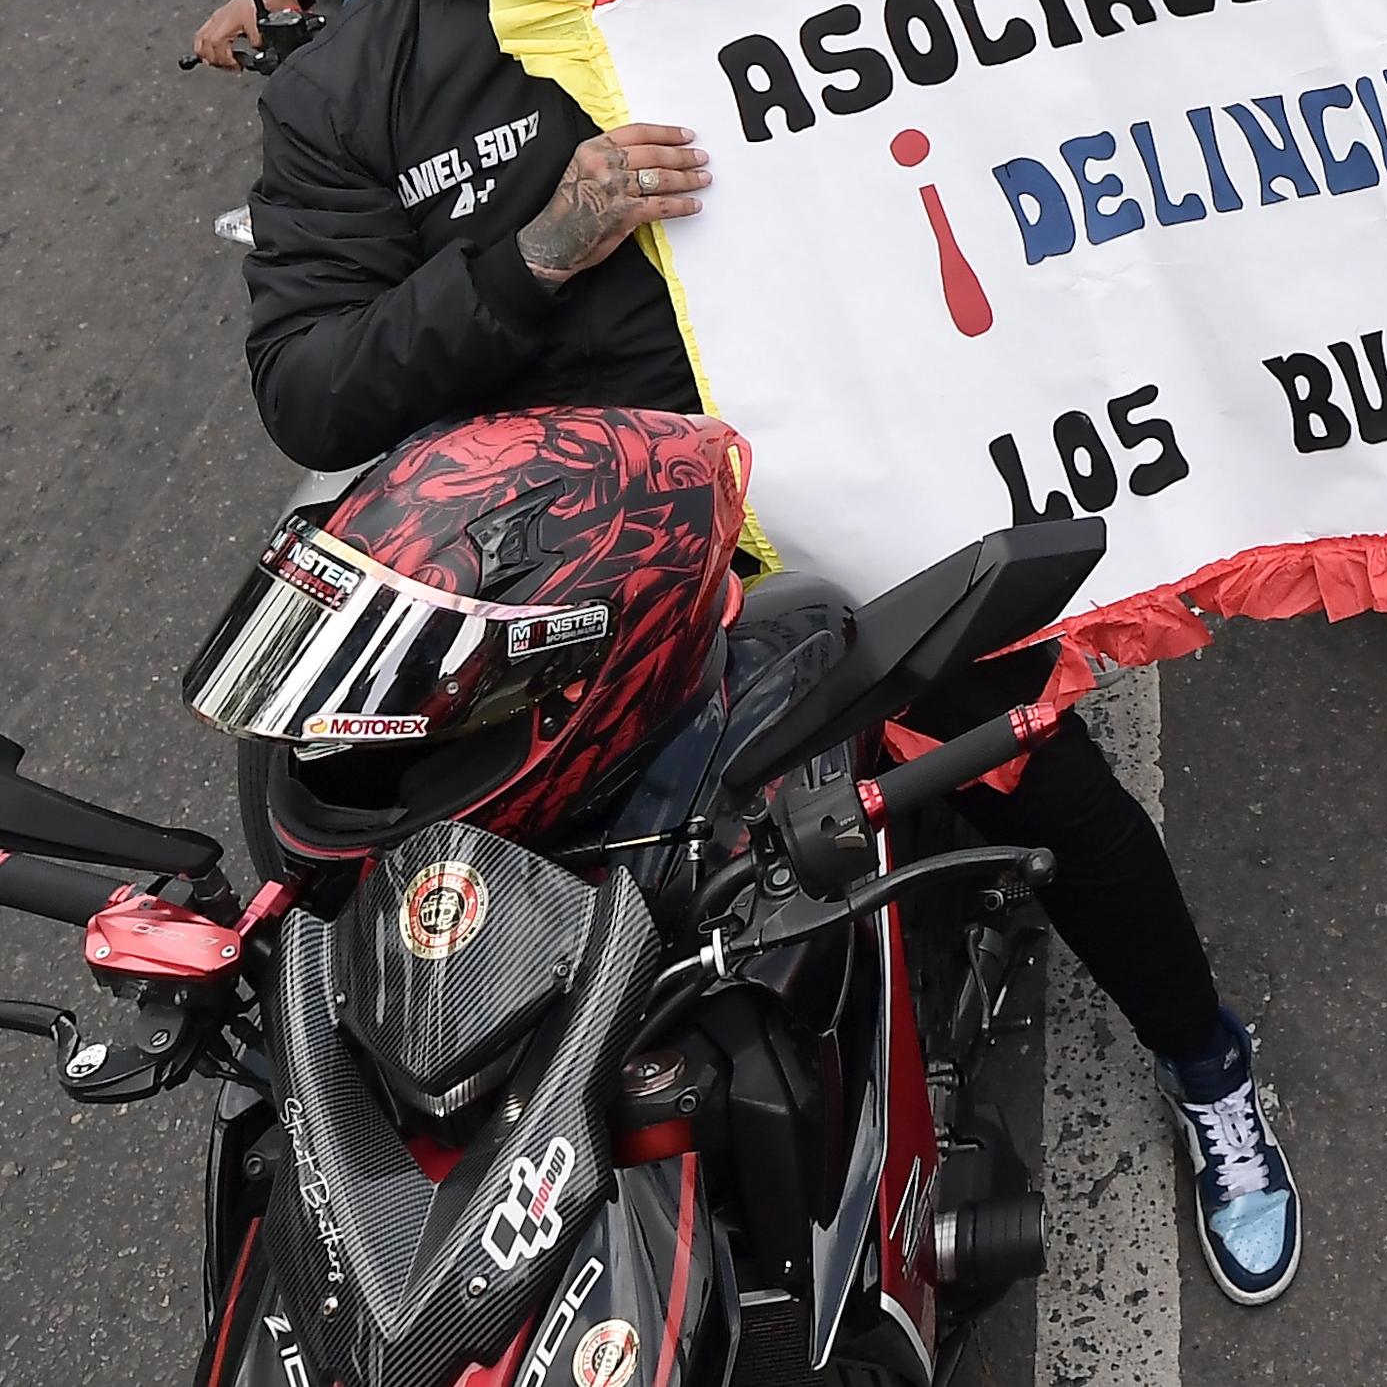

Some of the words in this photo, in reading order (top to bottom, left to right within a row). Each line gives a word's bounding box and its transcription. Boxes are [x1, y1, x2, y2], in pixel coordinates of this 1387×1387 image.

[987, 385, 1190, 524] LOS
[330, 719, 426, 735] MOTOREX
[530, 1145, 568, 1222] motogp
